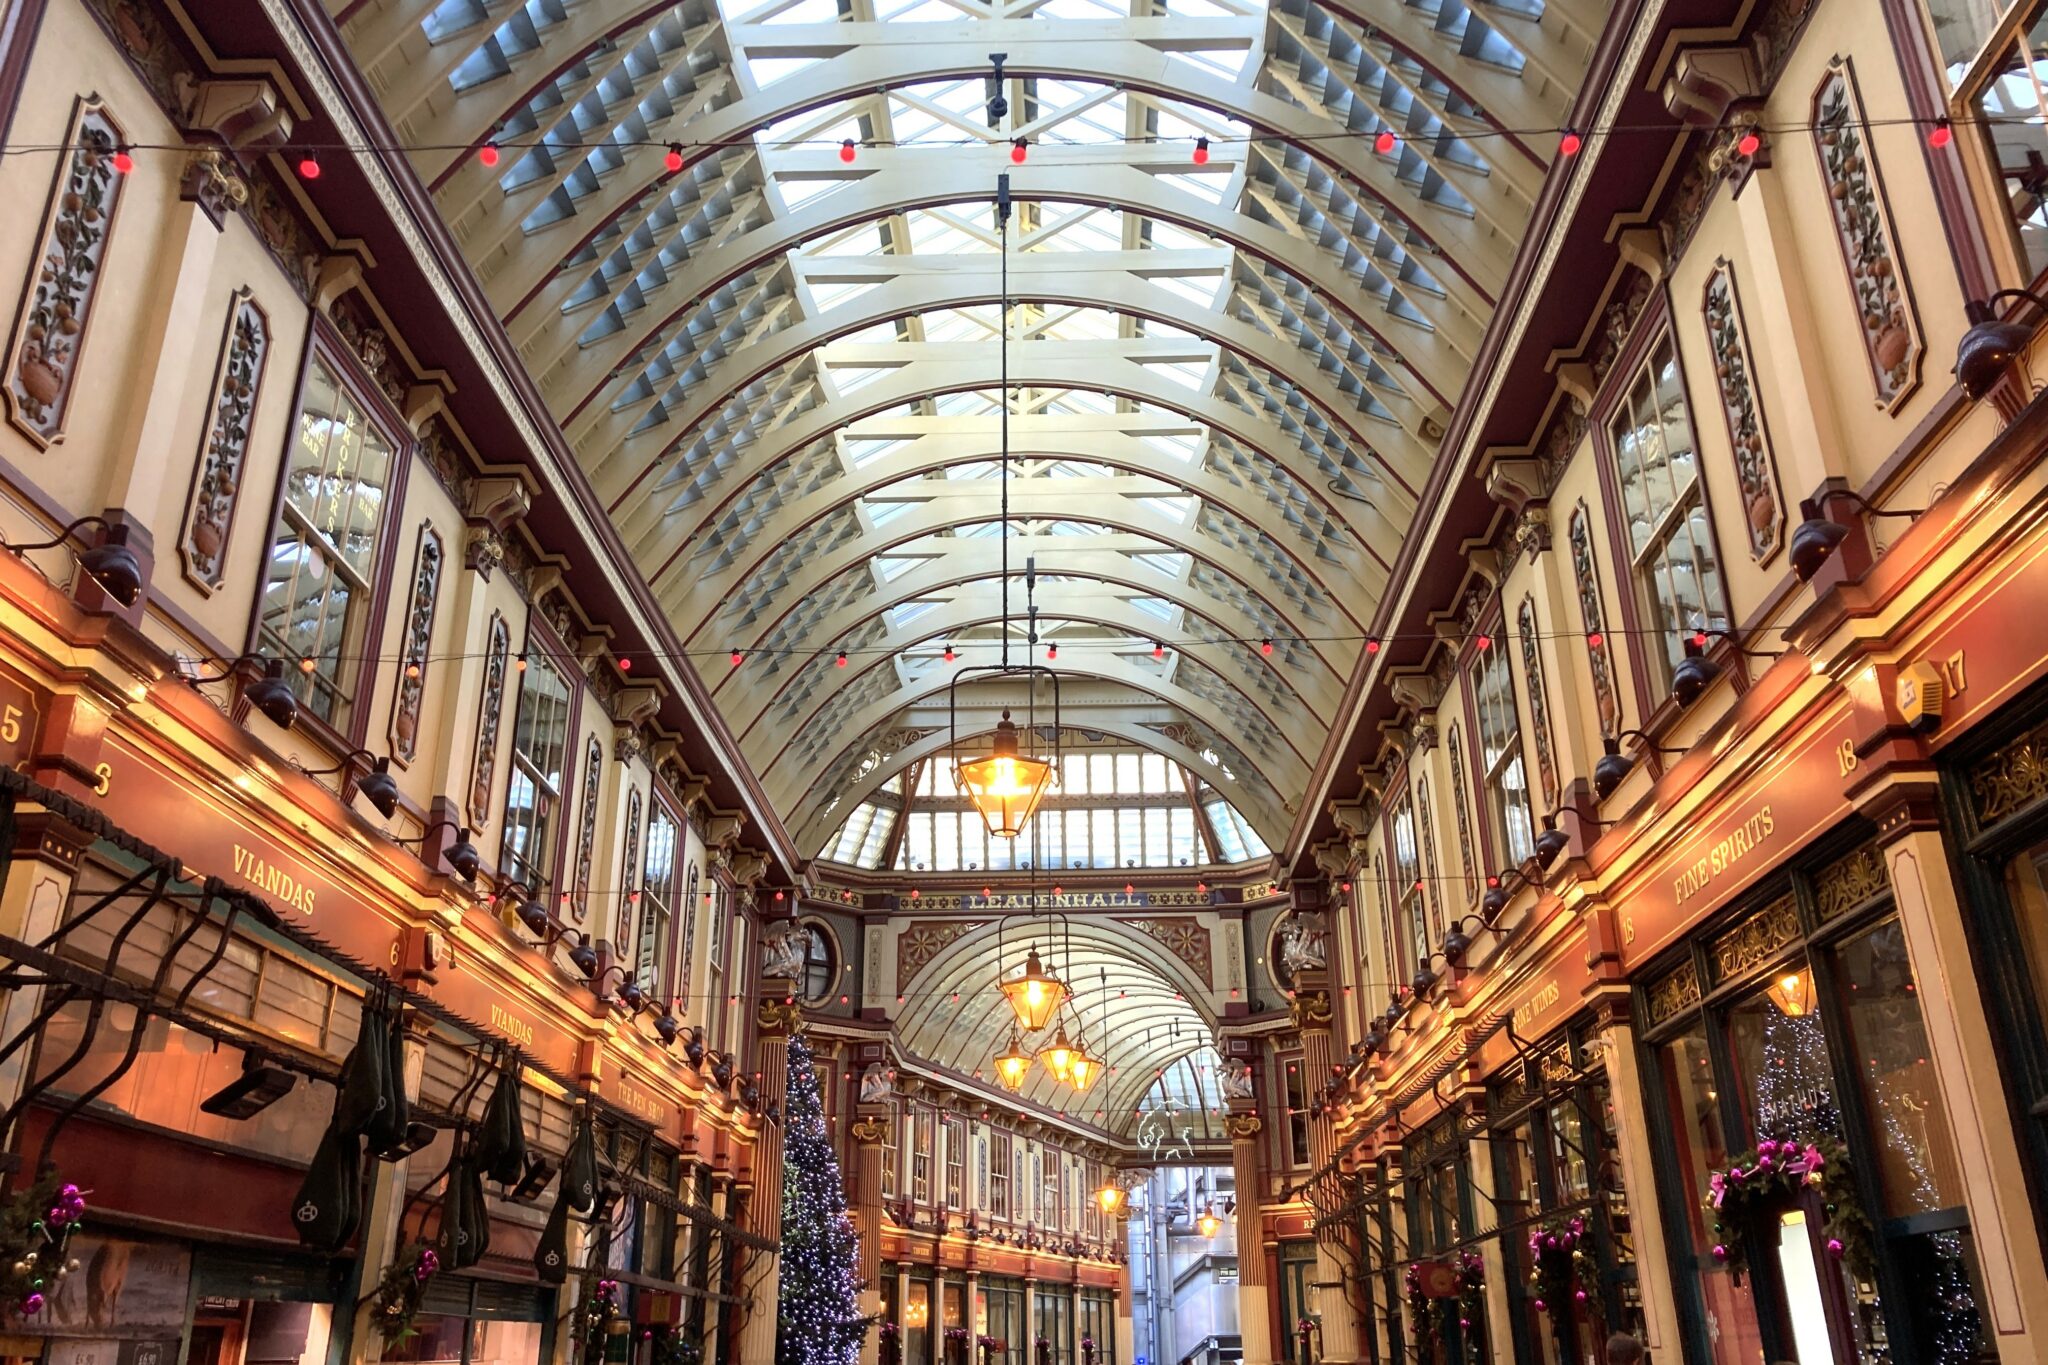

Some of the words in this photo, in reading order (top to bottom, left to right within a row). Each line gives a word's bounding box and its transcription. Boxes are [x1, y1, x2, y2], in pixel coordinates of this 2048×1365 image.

[302, 430, 319, 459] BAR
[327, 408, 356, 533] BROKERS
[359, 496, 374, 522] BAR
[1941, 648, 1966, 699] 17
[1, 703, 23, 743] 5
[1836, 738, 1857, 778] 18
[1674, 856, 1711, 905] FINE
[1711, 804, 1774, 877] SPIRITS
[233, 843, 316, 916] VIANDAS
[969, 892, 1141, 910] LEADENHALL
[1623, 917, 1635, 945] 18
[390, 942, 400, 966] 6
[1531, 979, 1559, 1017] WINES
[491, 1003, 533, 1046] VIANDAS
[617, 1081, 632, 1105] THE
